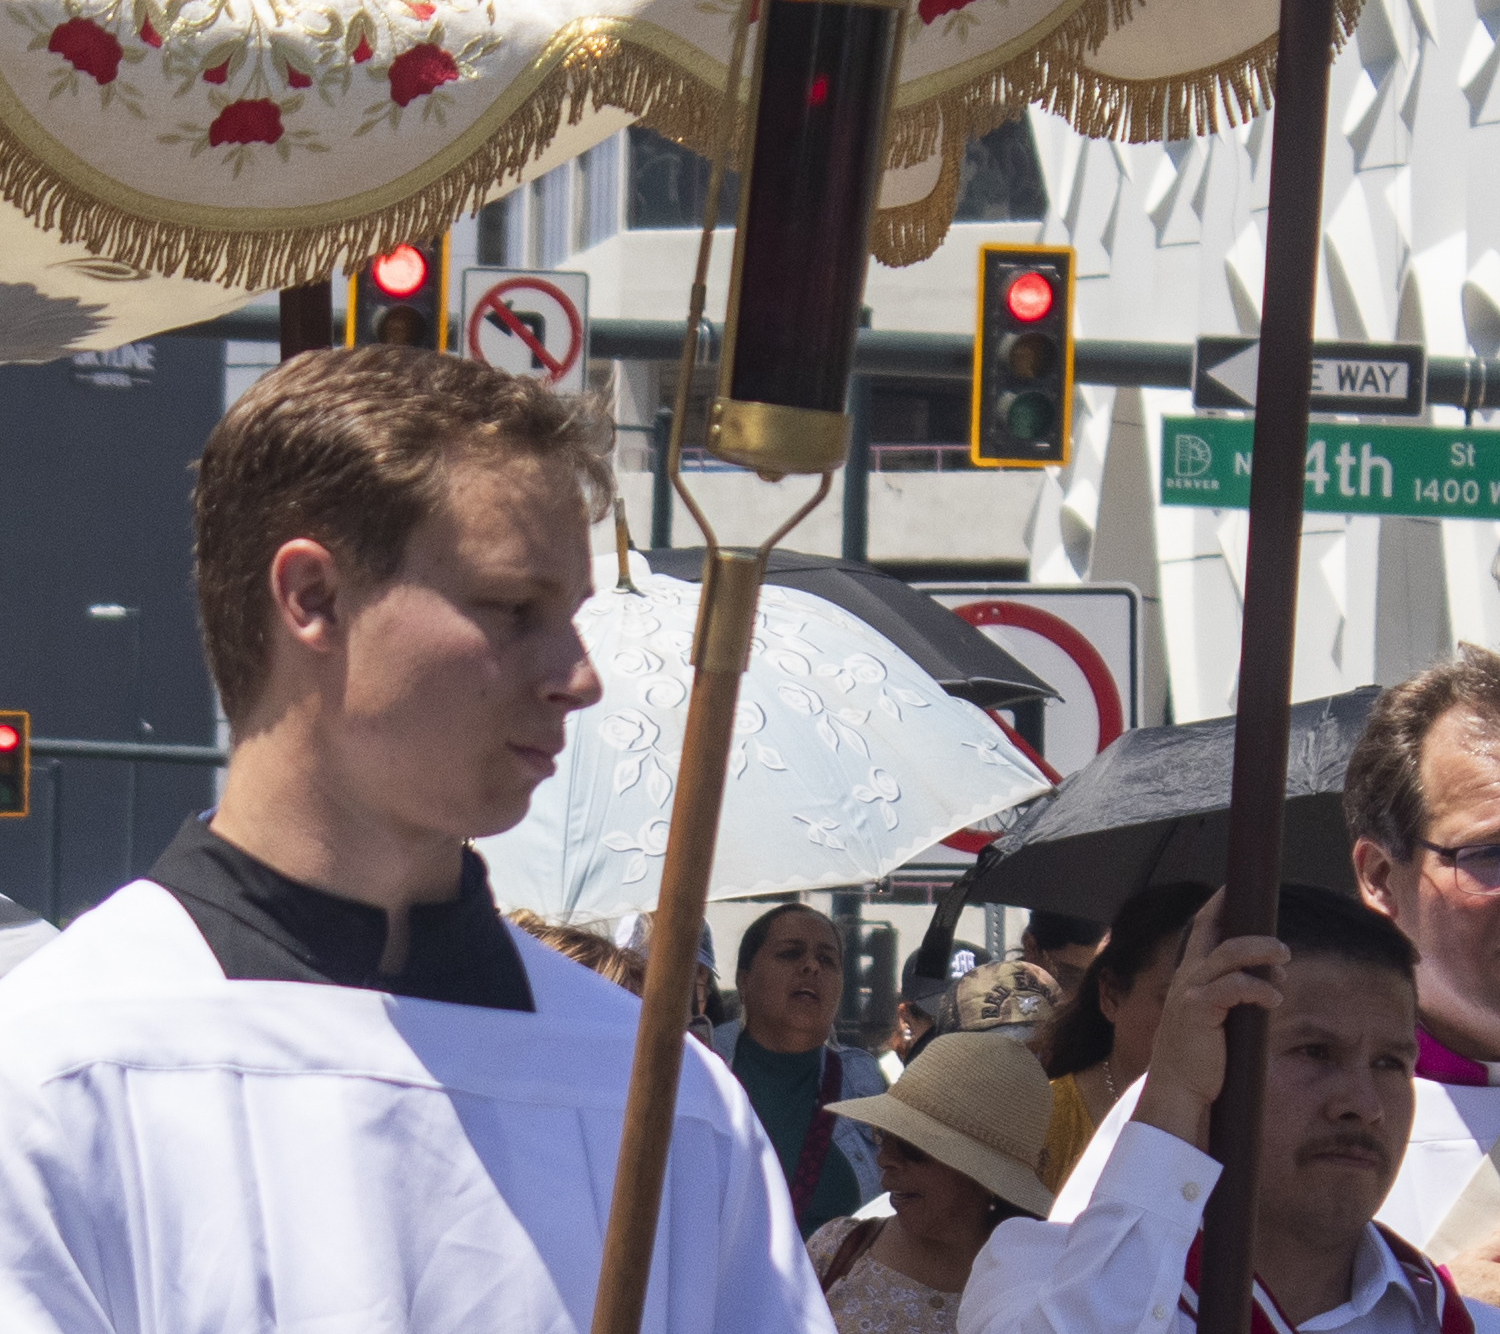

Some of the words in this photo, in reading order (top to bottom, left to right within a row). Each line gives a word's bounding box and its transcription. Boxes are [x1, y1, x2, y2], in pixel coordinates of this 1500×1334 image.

[1337, 364, 1400, 394] WAY
[1304, 439, 1393, 498] 4th
[1450, 442, 1476, 468] St
[1166, 478, 1220, 490] DENVER
[1414, 478, 1480, 504] 1400
